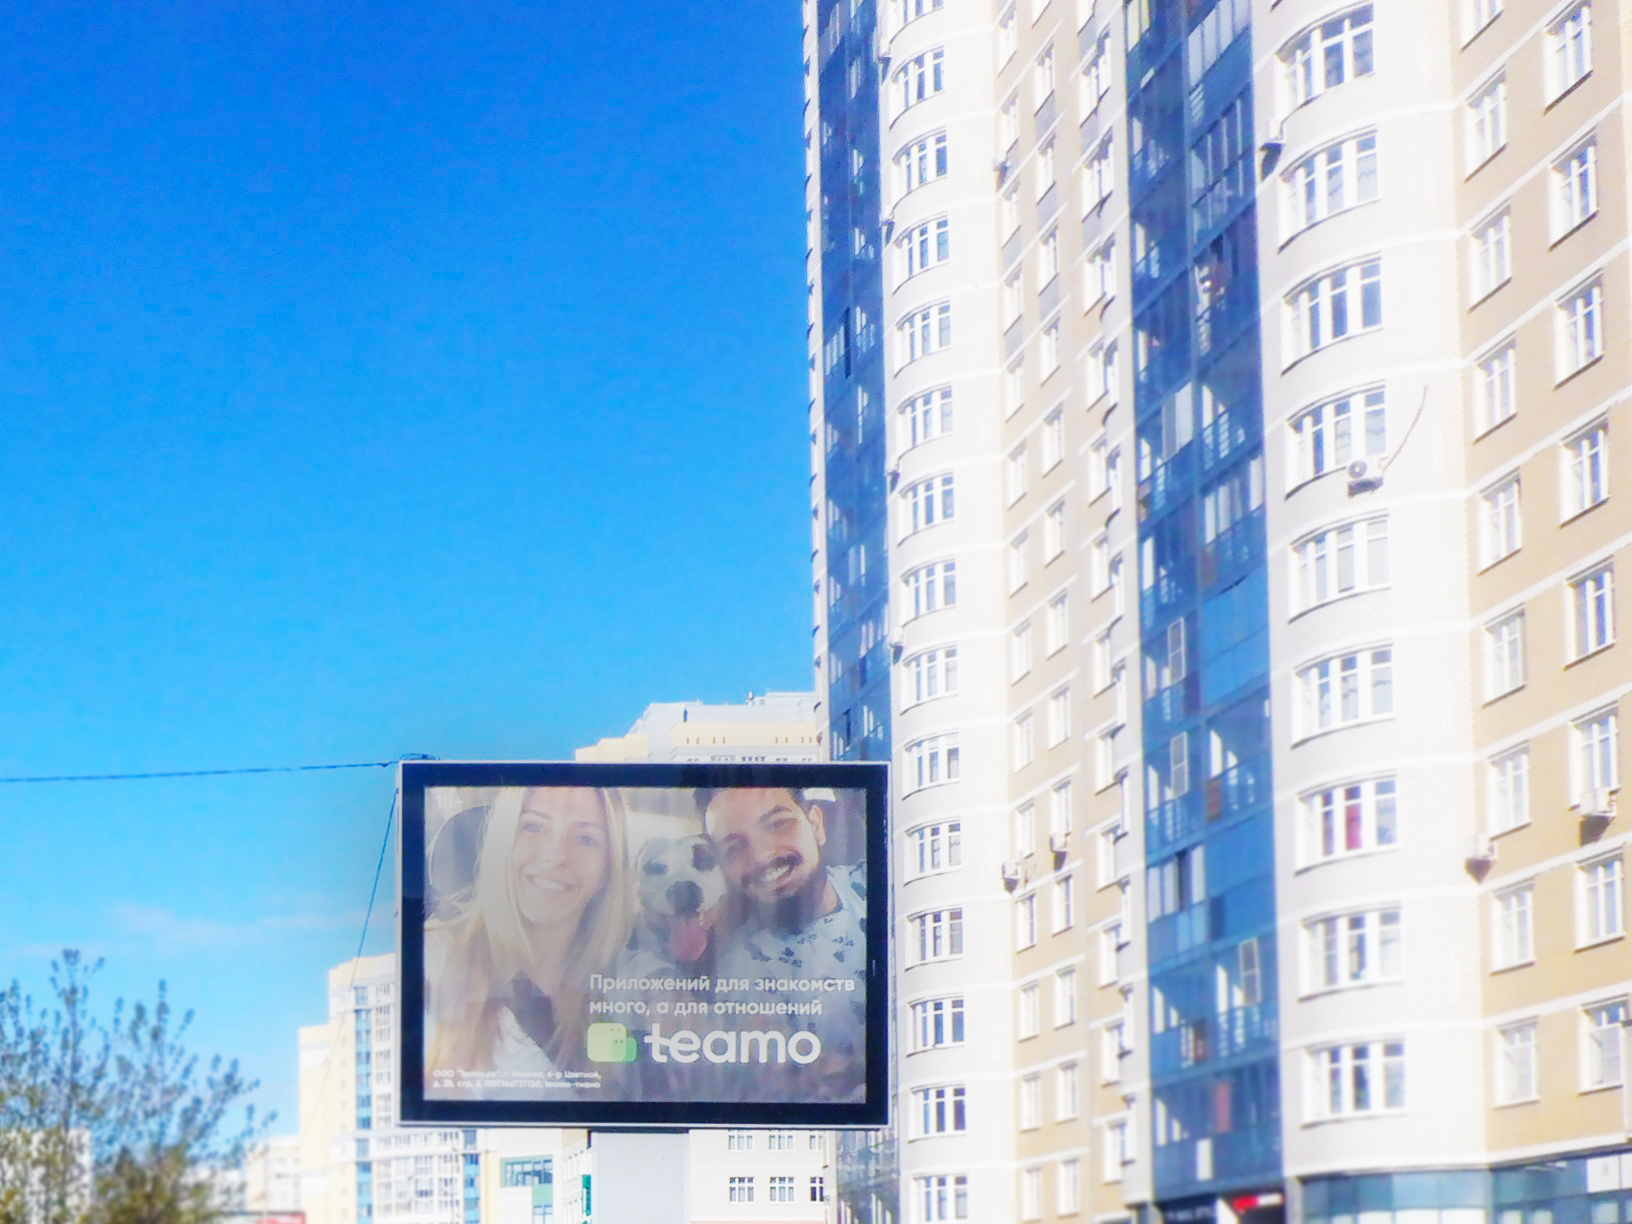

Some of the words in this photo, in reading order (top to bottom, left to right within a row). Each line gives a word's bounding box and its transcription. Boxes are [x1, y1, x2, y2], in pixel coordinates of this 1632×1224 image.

[435, 795, 464, 809] 18+
[589, 974, 709, 993] Приложений
[715, 977, 749, 993] для
[755, 978, 855, 992] знакомств
[589, 1001, 650, 1016] много,
[656, 1002, 669, 1015] а
[674, 1001, 708, 1016] для
[714, 1000, 822, 1015] отношений
[643, 1022, 821, 1064] teamo
[433, 1069, 454, 1078] ООО
